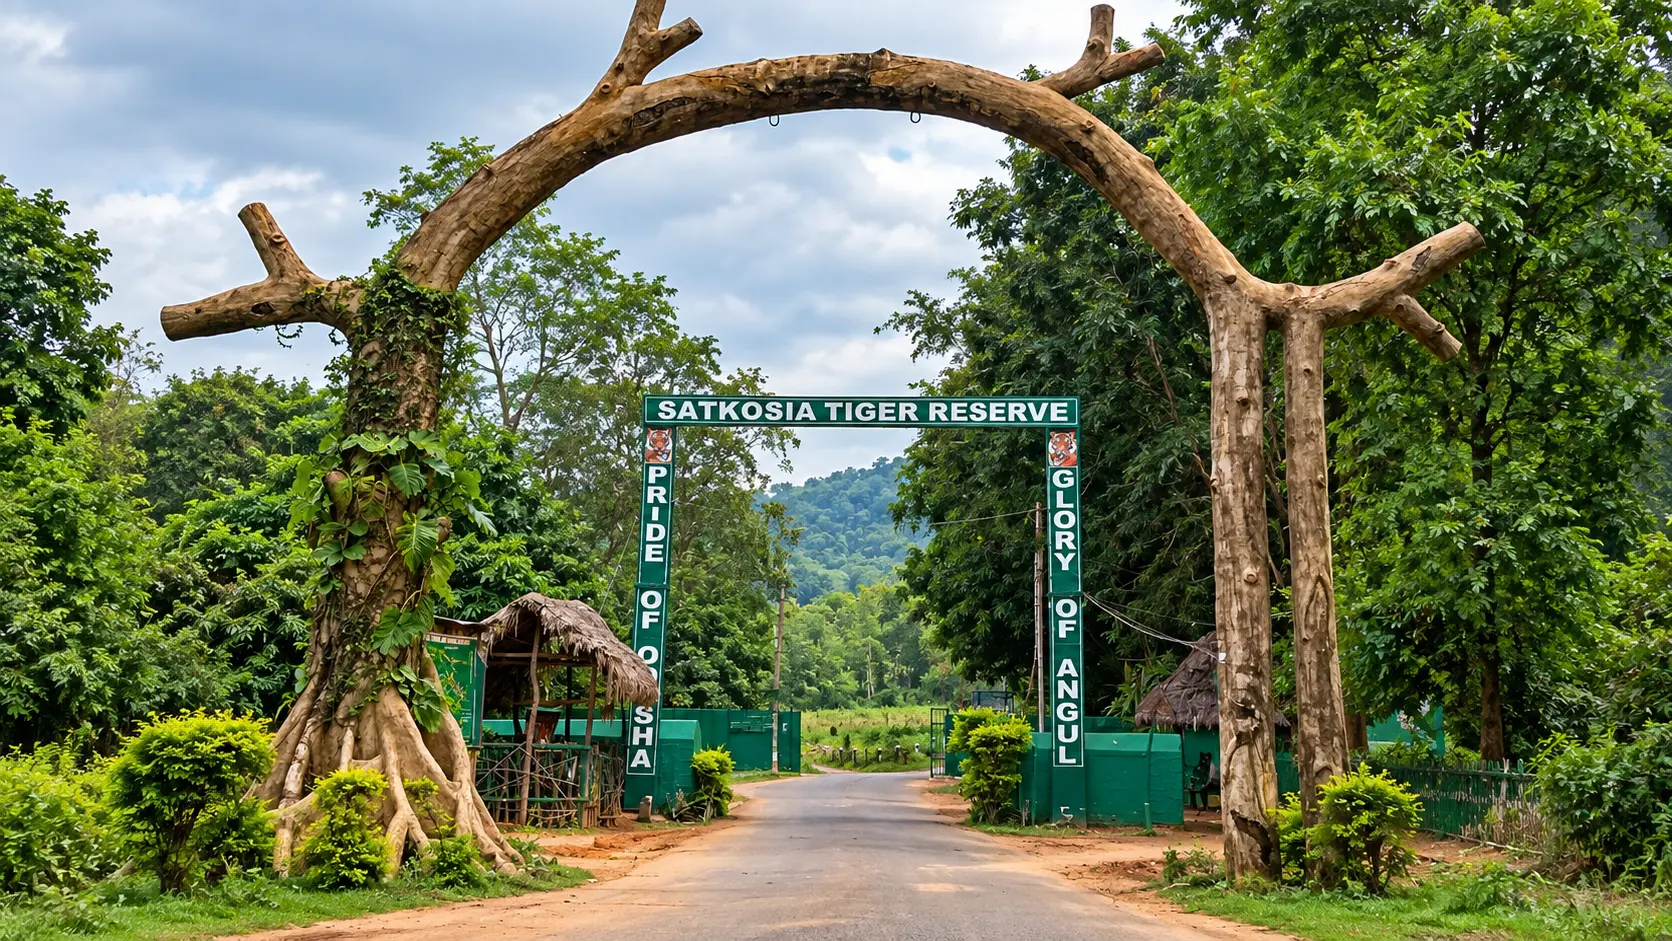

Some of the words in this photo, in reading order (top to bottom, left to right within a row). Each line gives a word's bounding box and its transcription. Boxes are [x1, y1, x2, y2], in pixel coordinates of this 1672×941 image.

[657, 400, 817, 421] SATKOSIA
[824, 402, 919, 422] TIGER
[928, 402, 1069, 422] RESERVE
[644, 465, 668, 563] PRIDE
[1052, 469, 1077, 571] GLORY
[640, 590, 662, 630] OF
[1055, 598, 1078, 639] OF
[630, 645, 660, 768] OSHA
[1056, 658, 1079, 764] ANGUL
